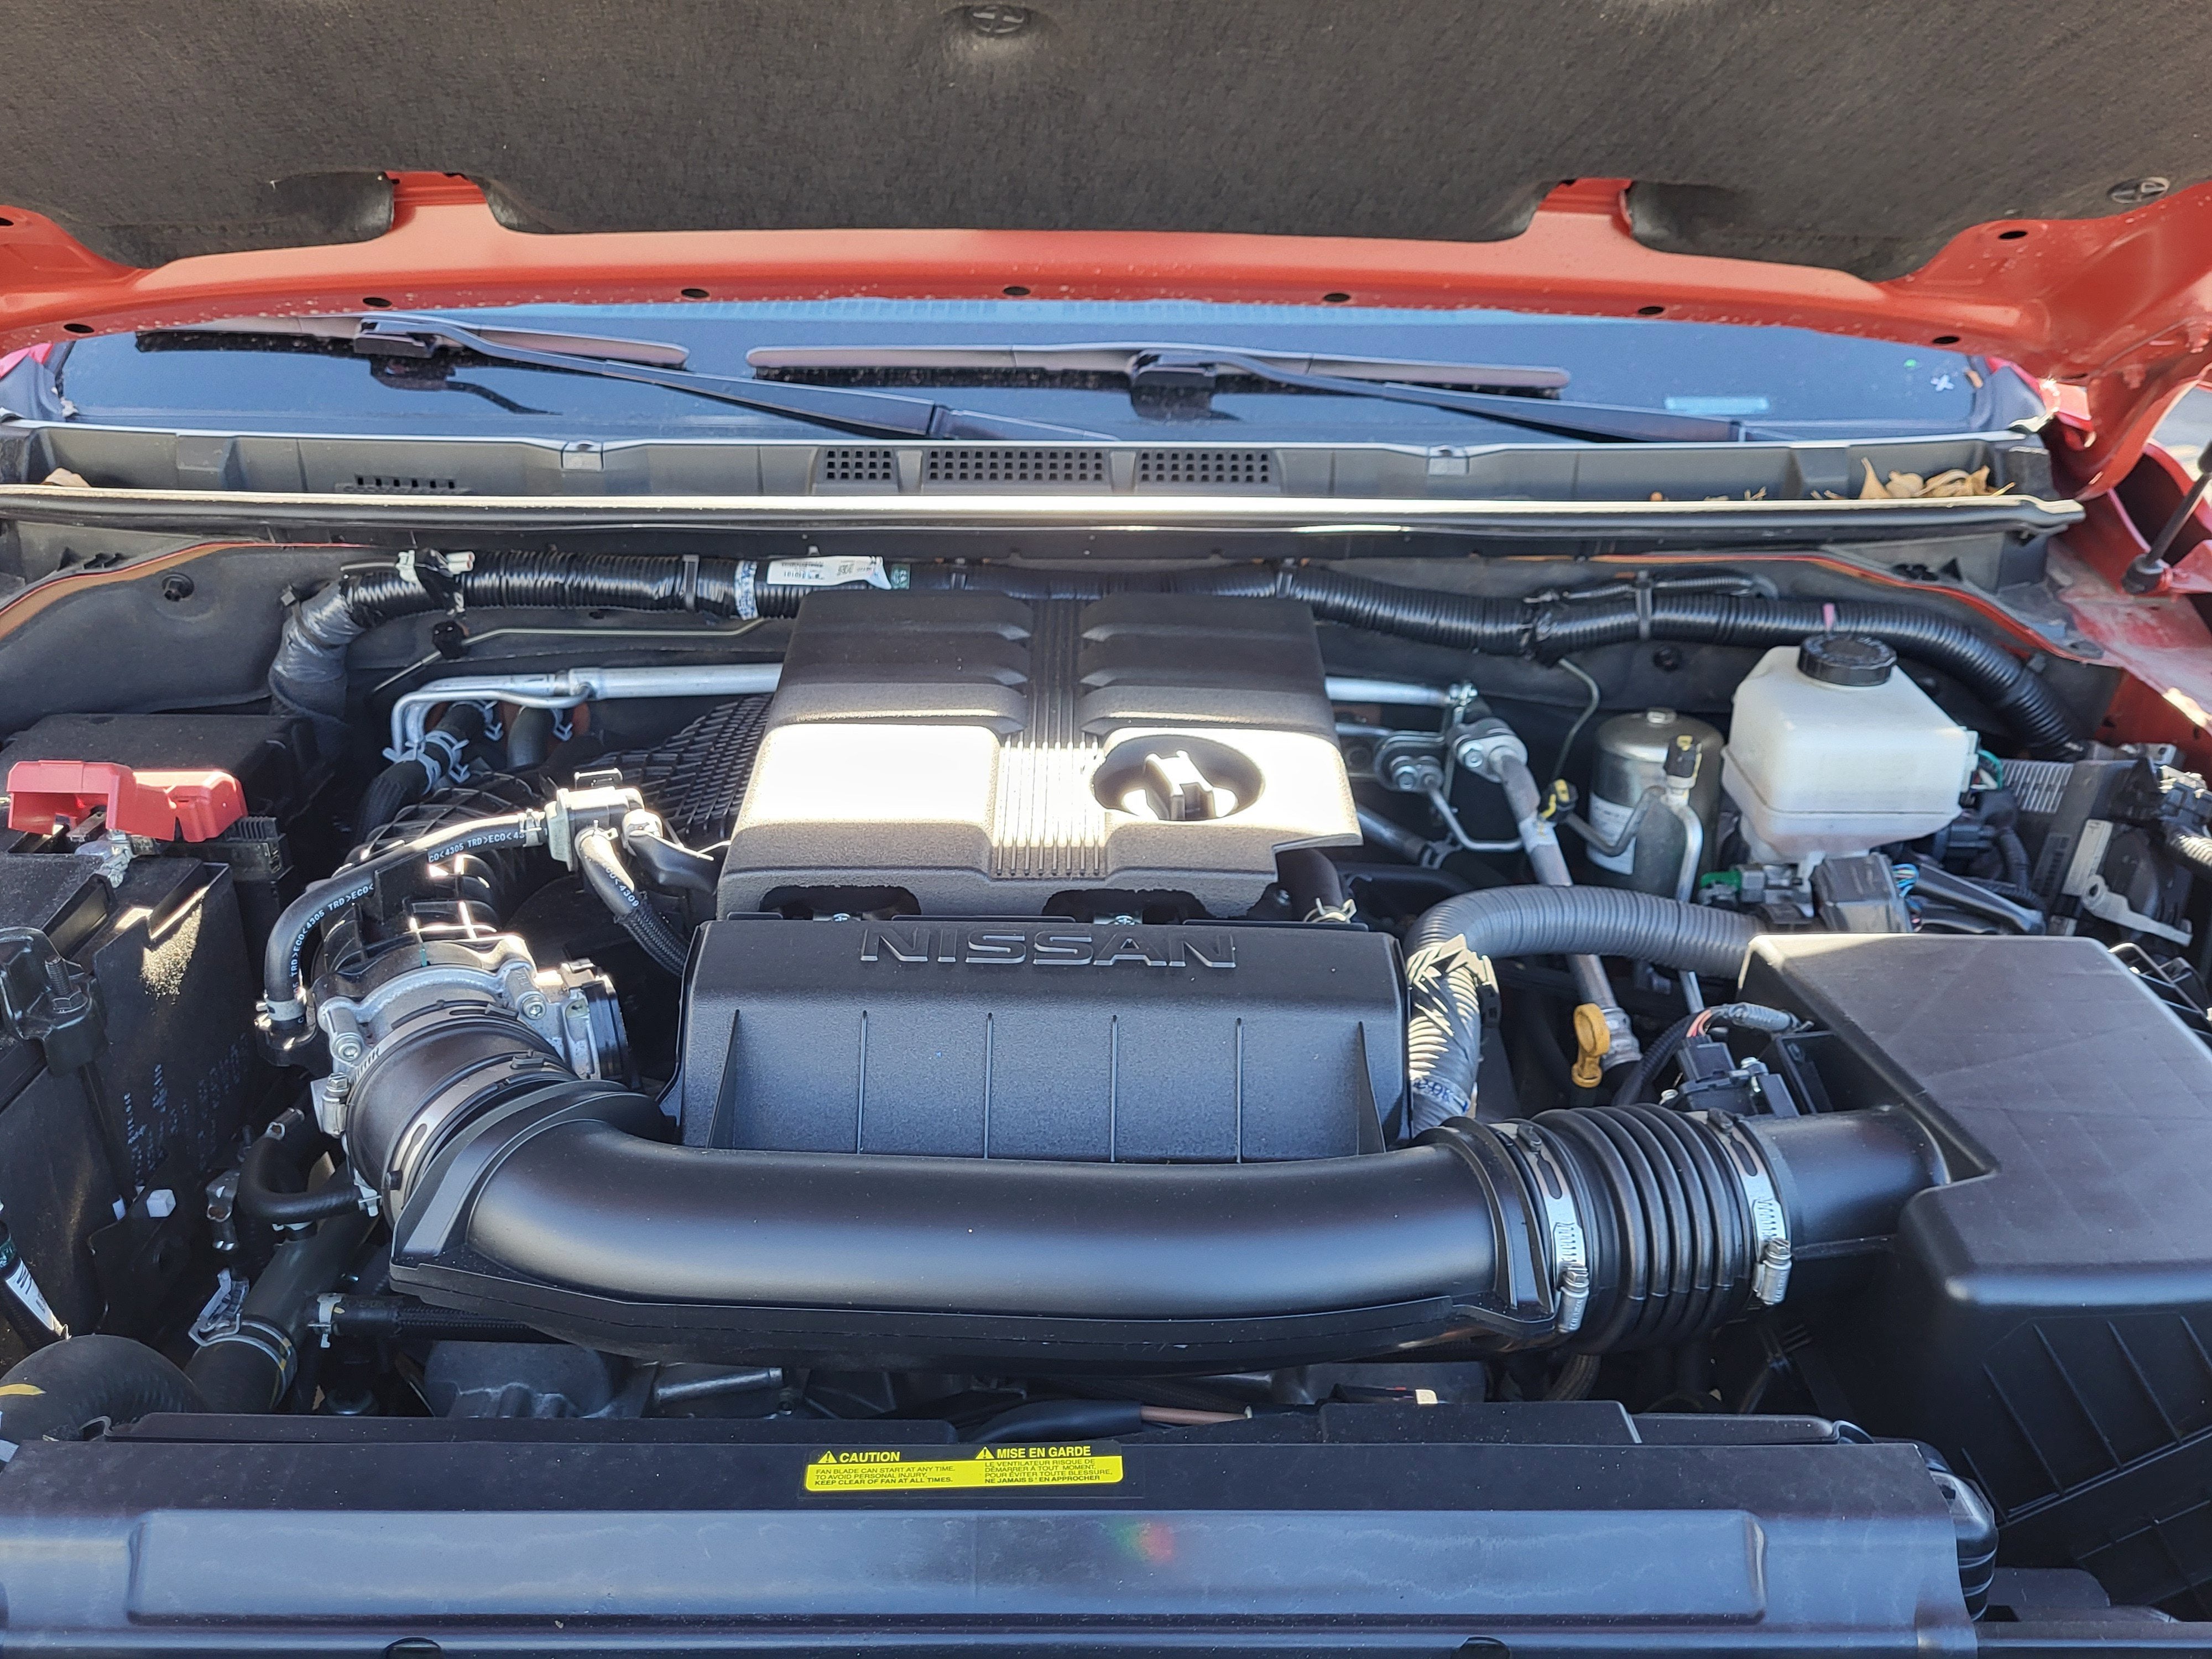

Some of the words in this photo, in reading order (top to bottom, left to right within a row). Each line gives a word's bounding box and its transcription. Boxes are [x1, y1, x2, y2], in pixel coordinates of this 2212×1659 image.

[328, 884, 374, 911] TRD>ECO<
[859, 927, 1236, 968] NISSAN
[839, 1452, 900, 1463] CAUTION
[997, 1448, 1026, 1458] MISE
[1029, 1447, 1045, 1457] EN
[1049, 1446, 1091, 1457] GARDE
